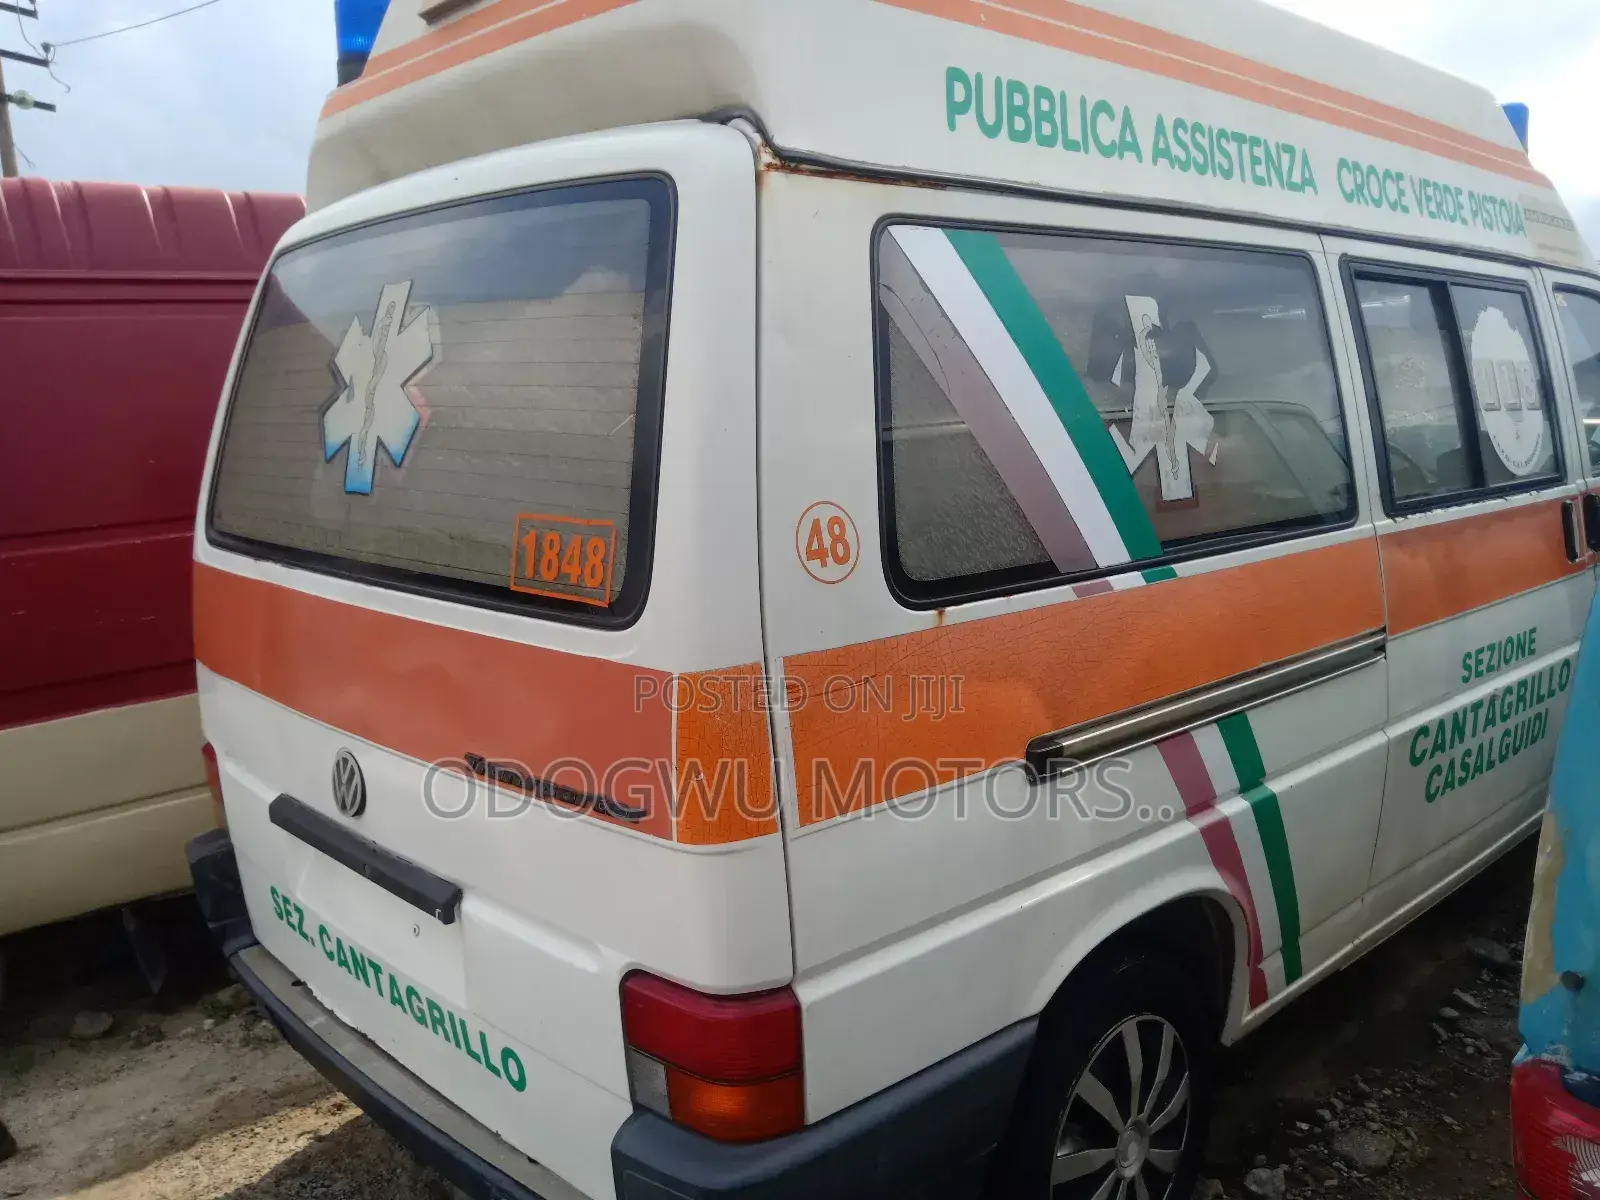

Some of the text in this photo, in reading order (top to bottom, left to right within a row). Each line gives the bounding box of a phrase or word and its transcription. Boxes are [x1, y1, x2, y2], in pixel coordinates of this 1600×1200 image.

[946, 66, 1143, 163] PUBBLICA
[1152, 113, 1318, 195] ASSISTENZA
[1337, 157, 1410, 214] CROCE
[1409, 174, 1468, 226] VERDE
[1467, 190, 1527, 238] PISTOIA
[522, 529, 607, 588] 1848
[806, 516, 851, 568] 48
[1461, 626, 1537, 684] SEZIONE
[1409, 658, 1570, 767] CANTAGRILLO
[1424, 708, 1548, 804] CASALGUIDI
[270, 885, 526, 1093] SEZ. CANTAGRILLO
